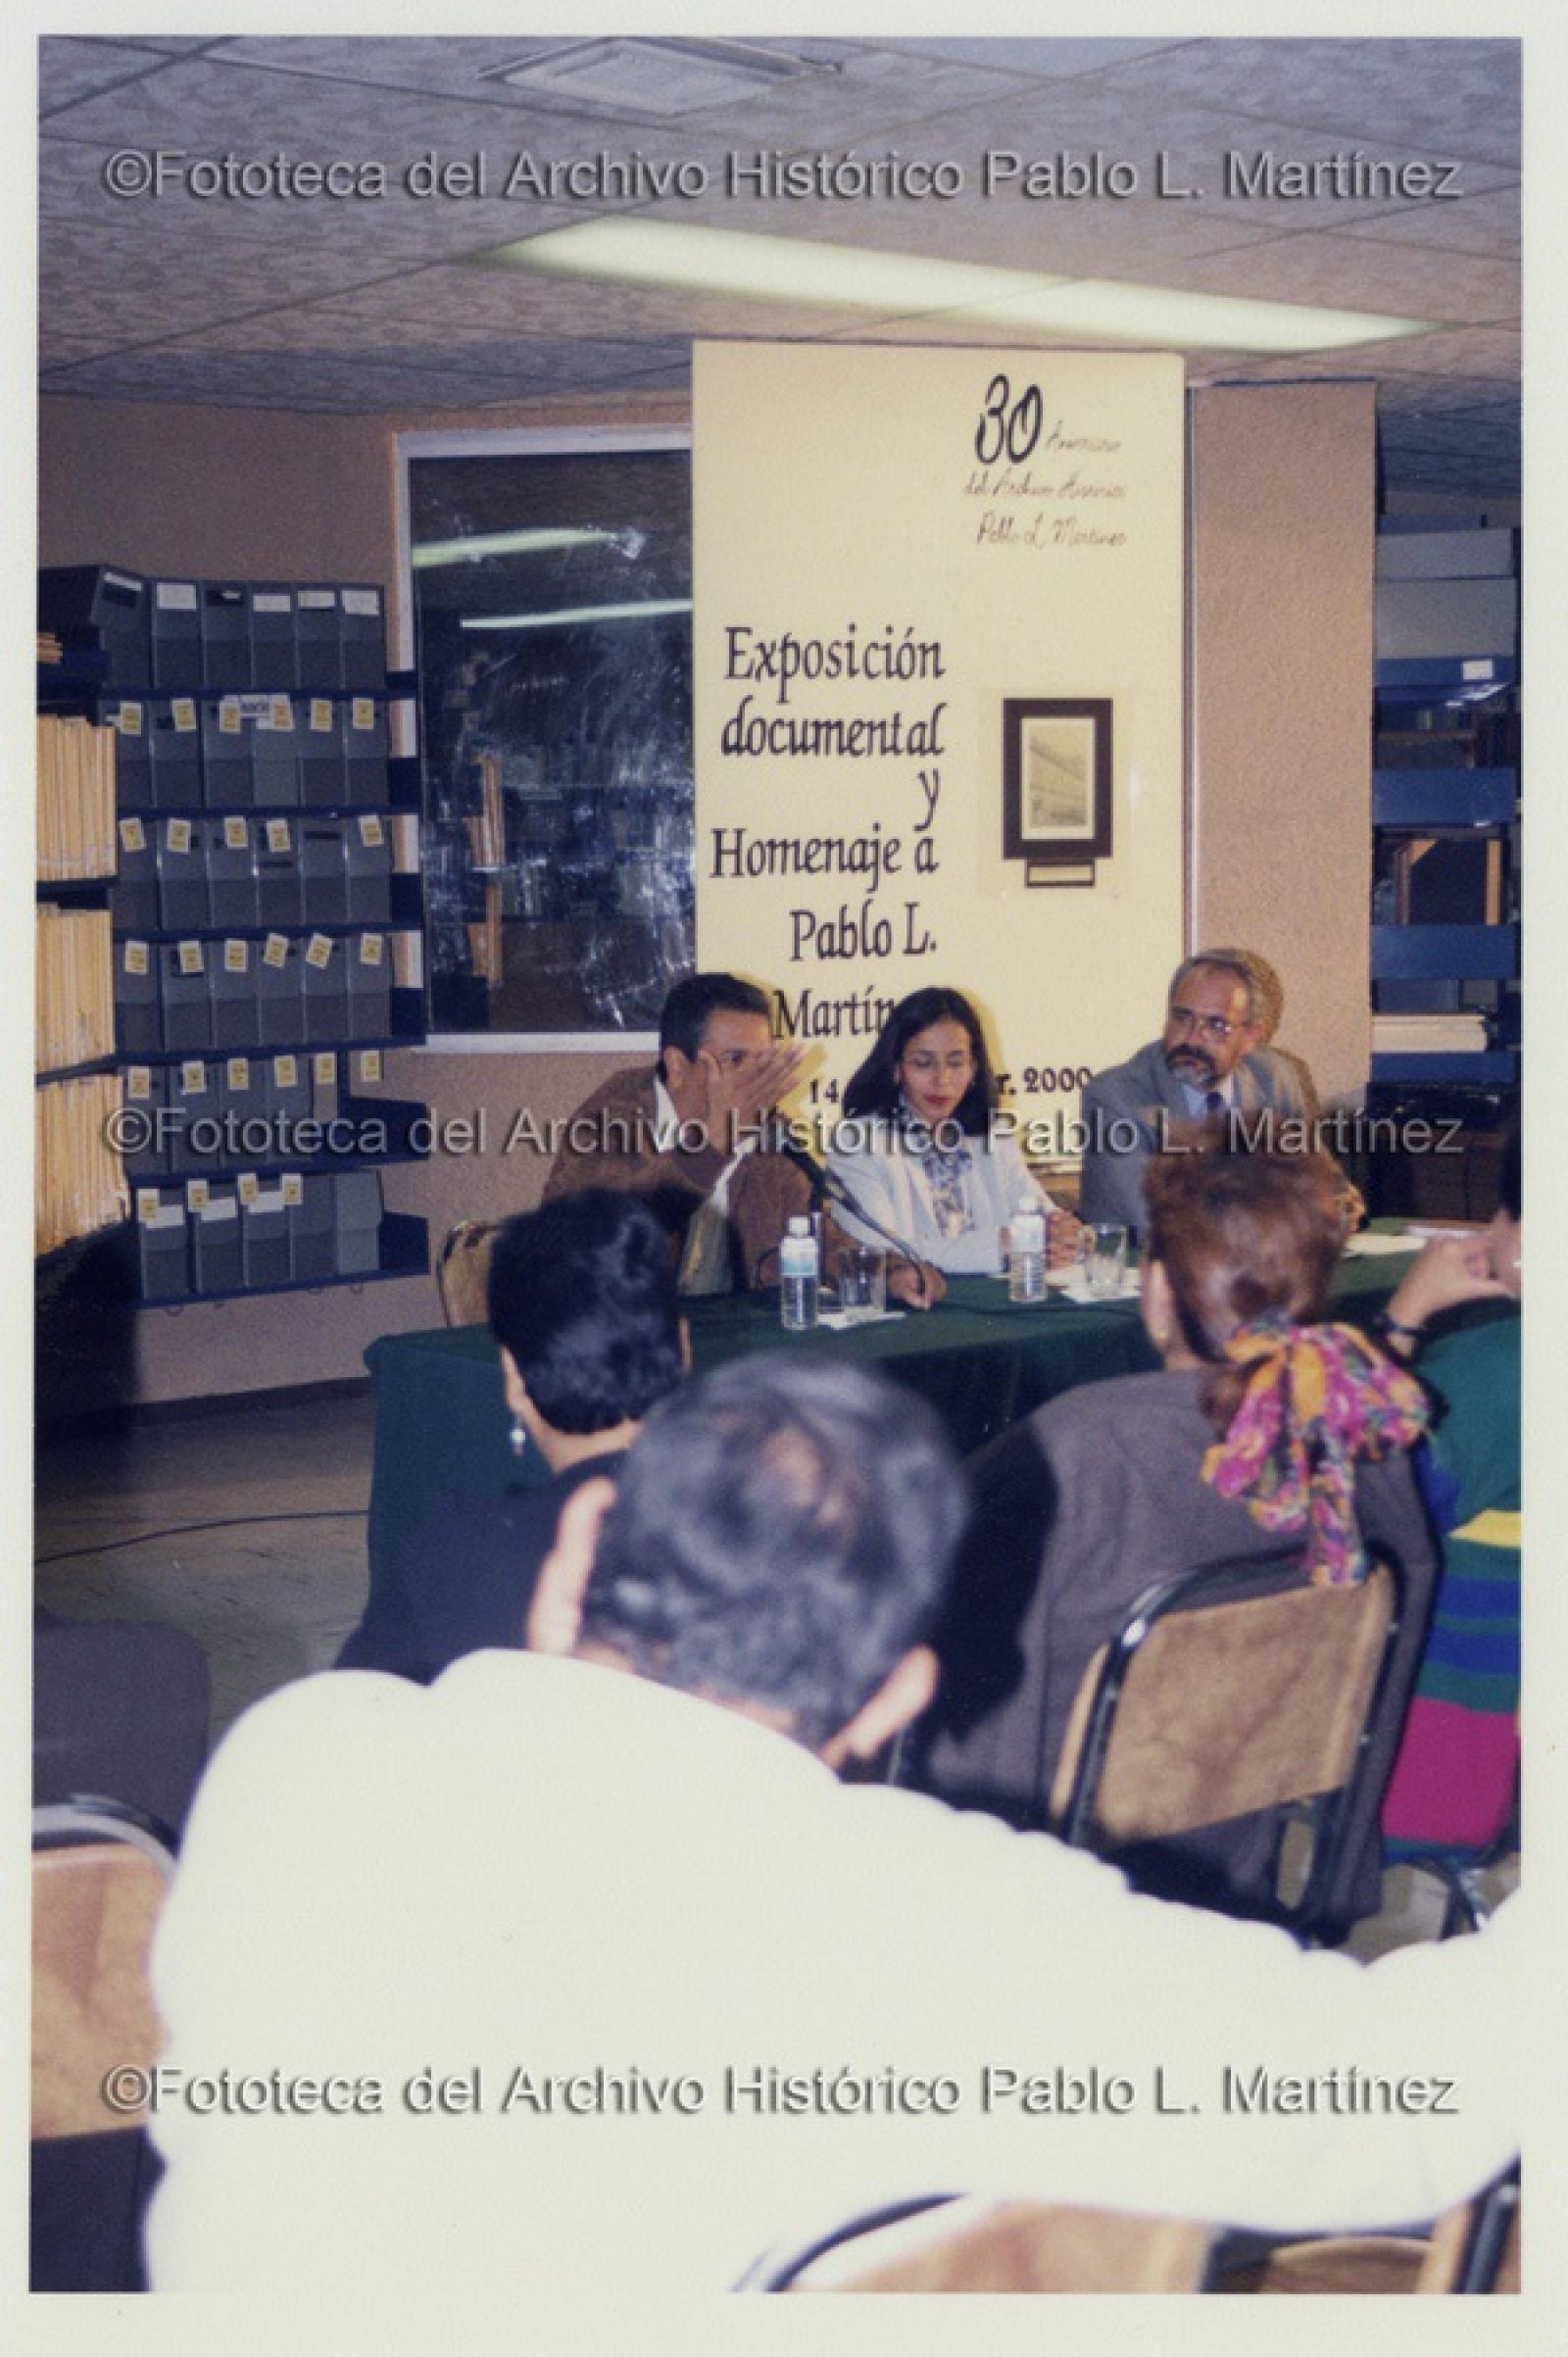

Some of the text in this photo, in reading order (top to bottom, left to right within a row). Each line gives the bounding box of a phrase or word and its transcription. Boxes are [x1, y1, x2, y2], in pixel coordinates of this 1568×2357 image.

[975, 373, 1043, 465] 30
[724, 622, 946, 705] Exposición
[721, 695, 948, 757] documental
[913, 768, 940, 831] y
[710, 821, 902, 894] Homenaje
[789, 898, 937, 961] Pablo L.
[772, 985, 894, 1040] Martín
[809, 1079, 840, 1104] 14
